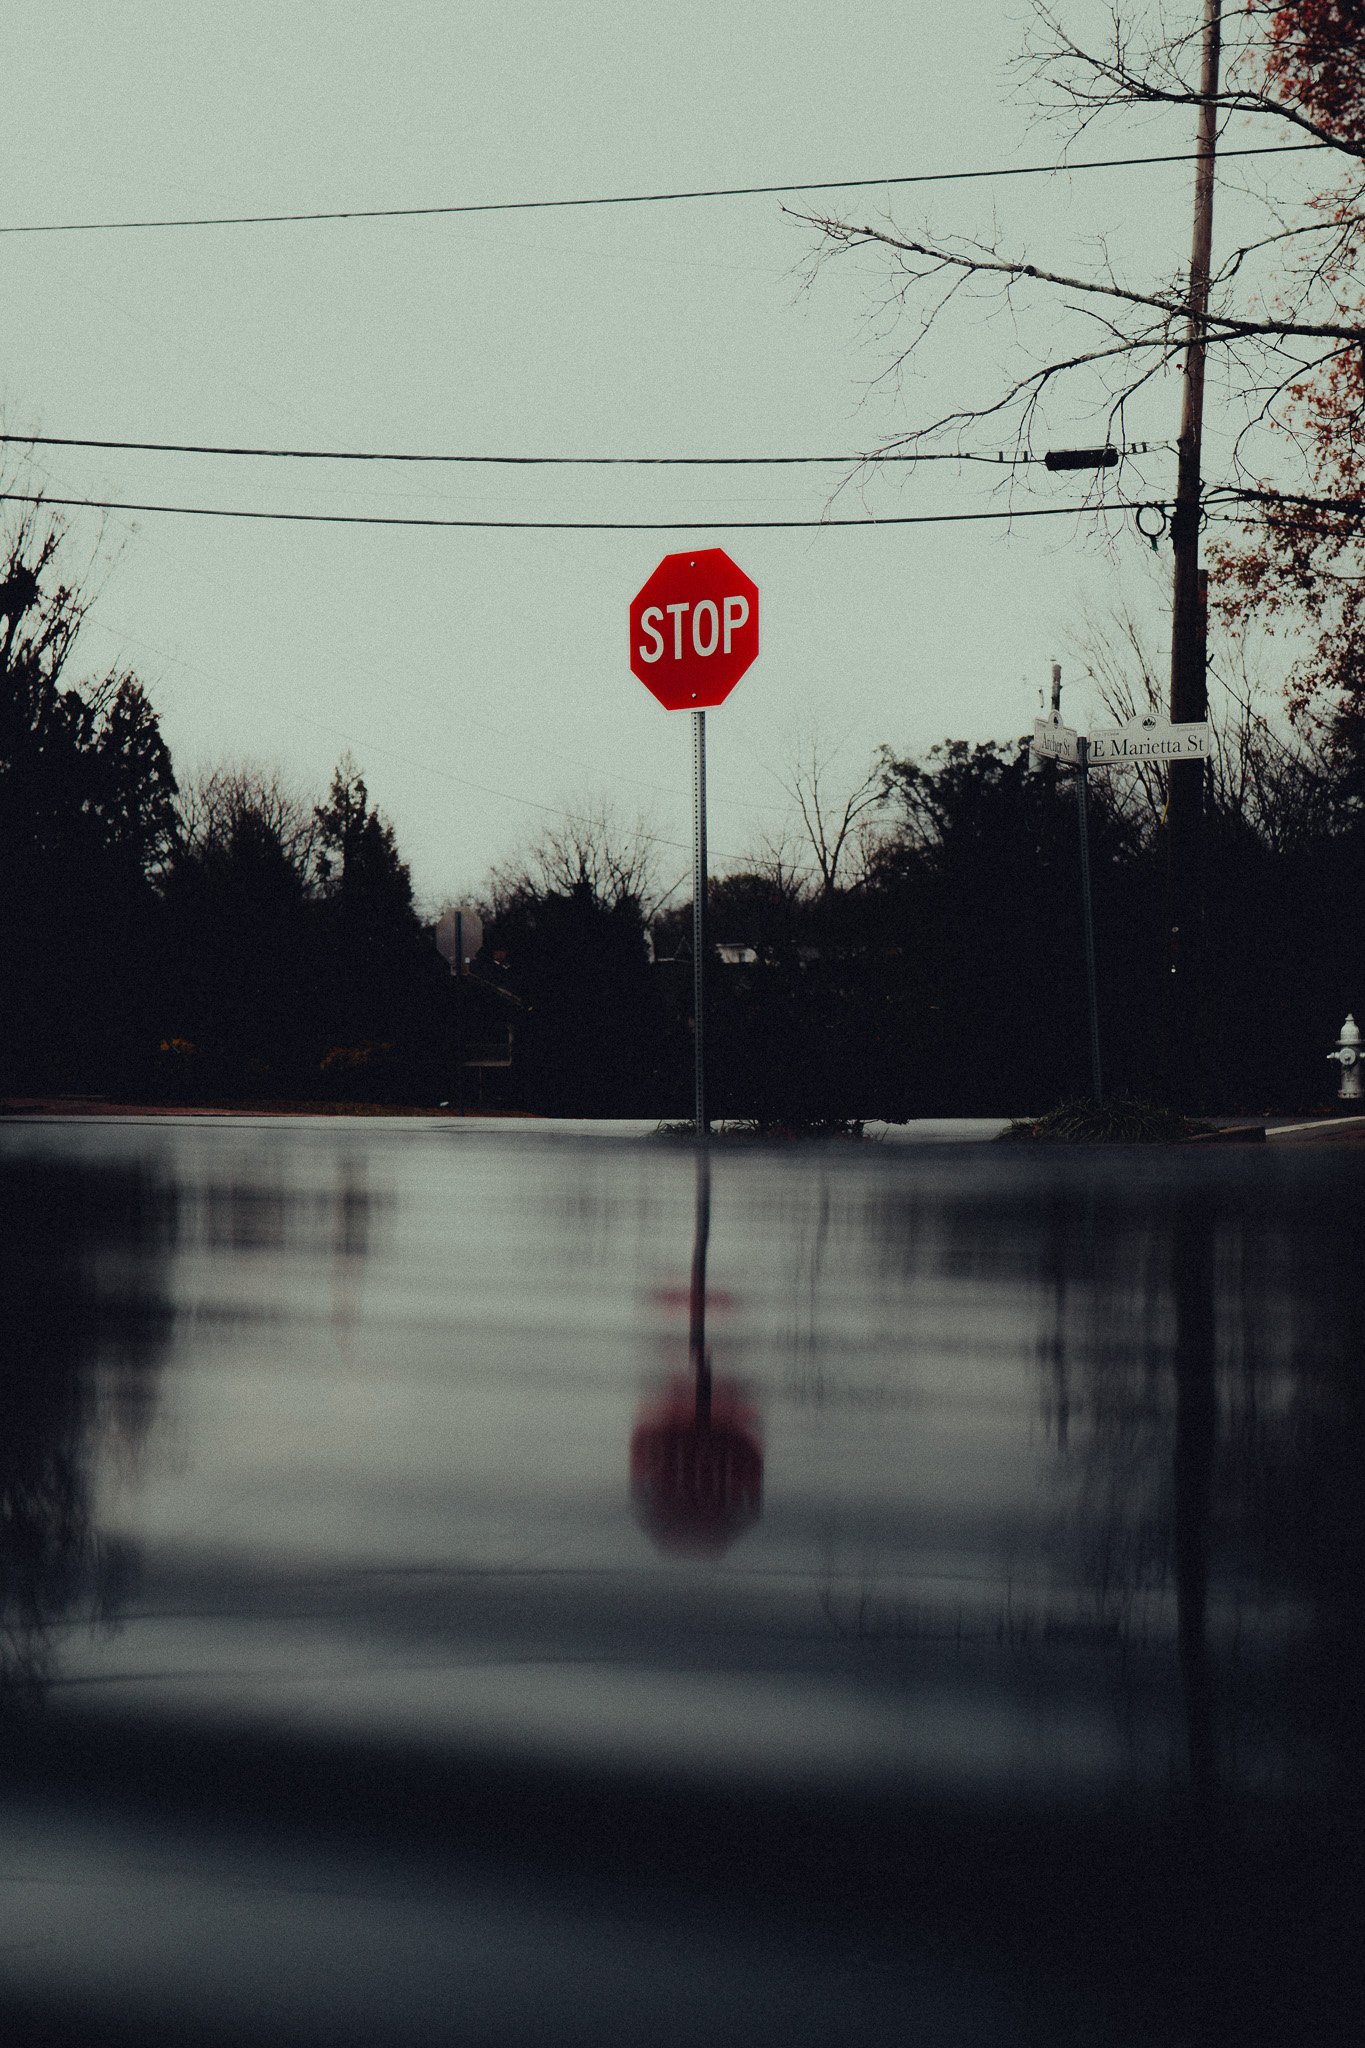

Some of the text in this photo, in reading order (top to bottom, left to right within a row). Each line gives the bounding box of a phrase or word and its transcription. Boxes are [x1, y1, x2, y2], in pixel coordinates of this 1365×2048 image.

[639, 595, 750, 664] STOP
[1093, 734, 1205, 757] E Marietta St
